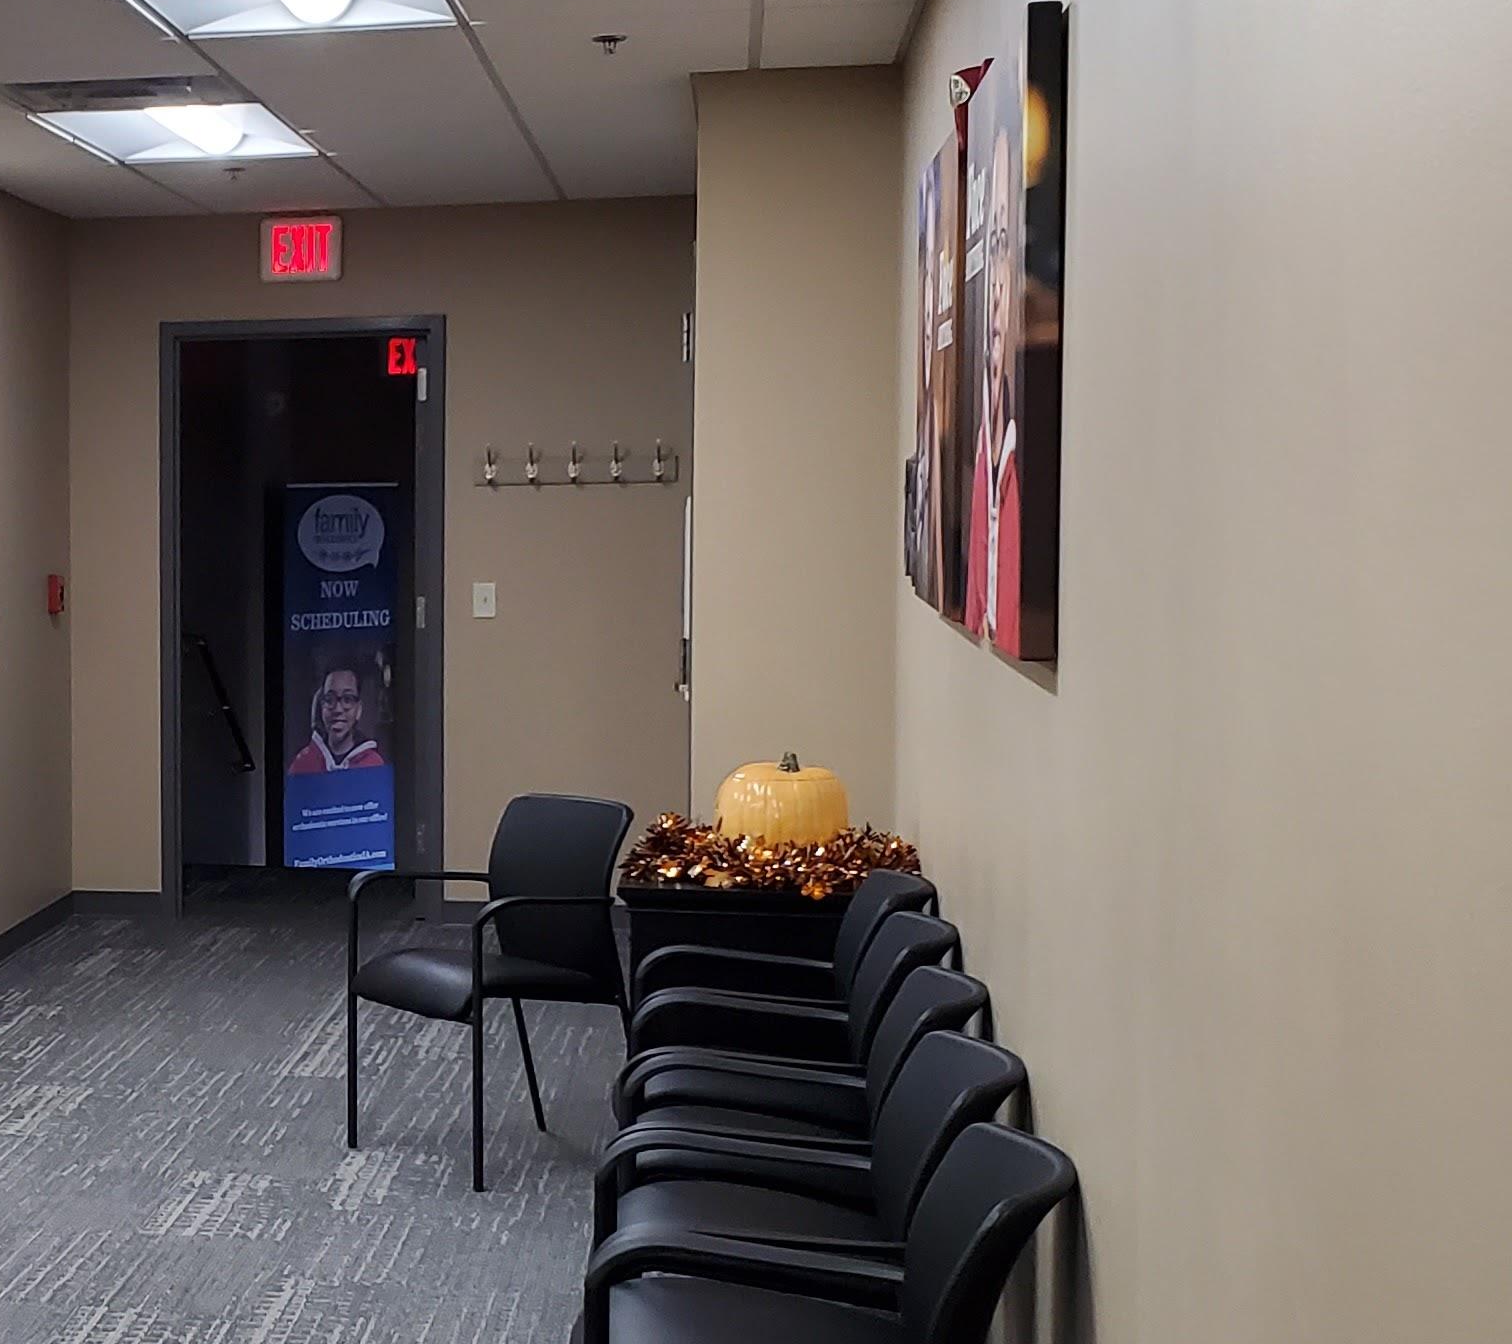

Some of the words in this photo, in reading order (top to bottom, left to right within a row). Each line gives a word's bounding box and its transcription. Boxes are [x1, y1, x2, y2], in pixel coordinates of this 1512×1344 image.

[271, 224, 333, 274] EXIT
[387, 338, 417, 375] EX
[320, 580, 359, 598] NOW
[290, 609, 391, 631] SCHEDULING
